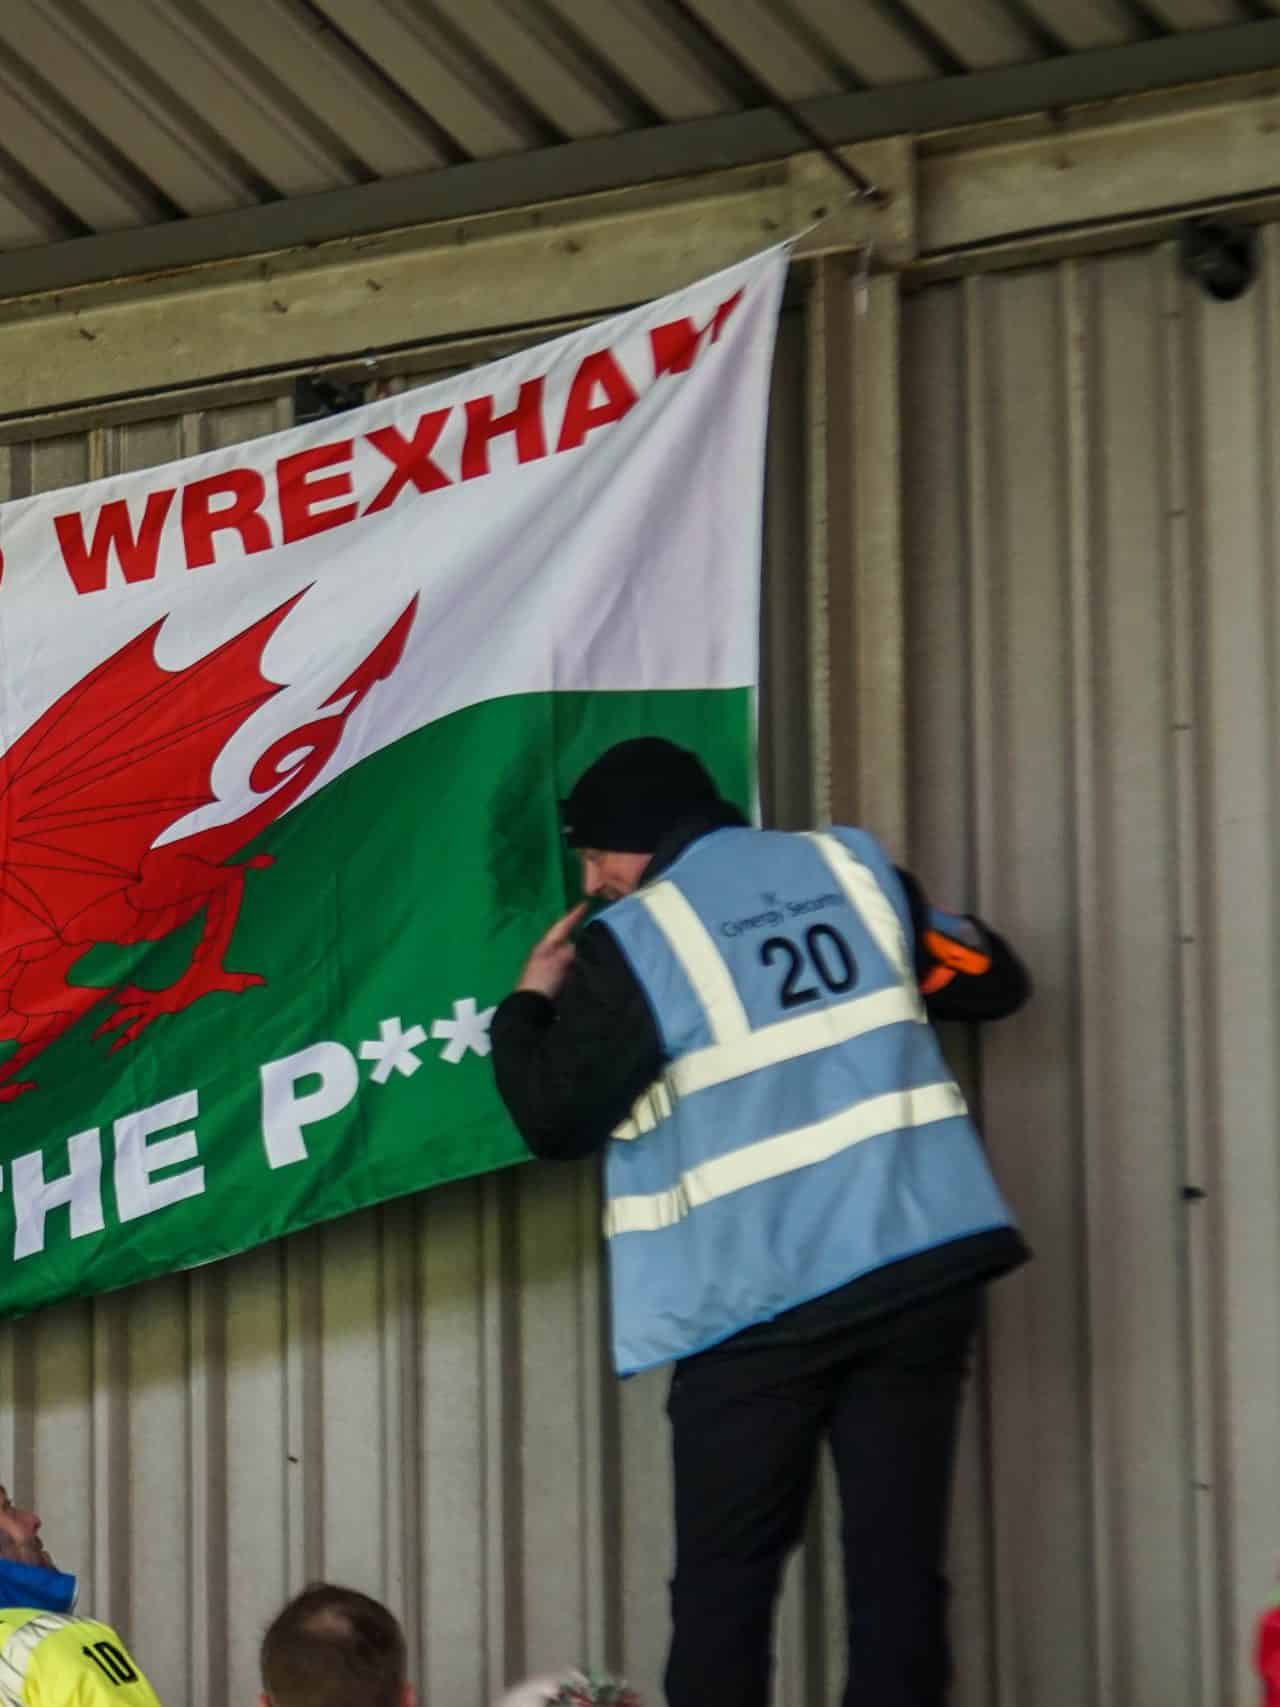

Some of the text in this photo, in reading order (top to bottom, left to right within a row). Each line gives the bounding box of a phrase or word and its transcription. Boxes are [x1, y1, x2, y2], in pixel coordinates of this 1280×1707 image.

[53, 286, 746, 596] WREXHAM
[760, 922, 858, 1010] 20
[82, 1640, 138, 1687] 10
